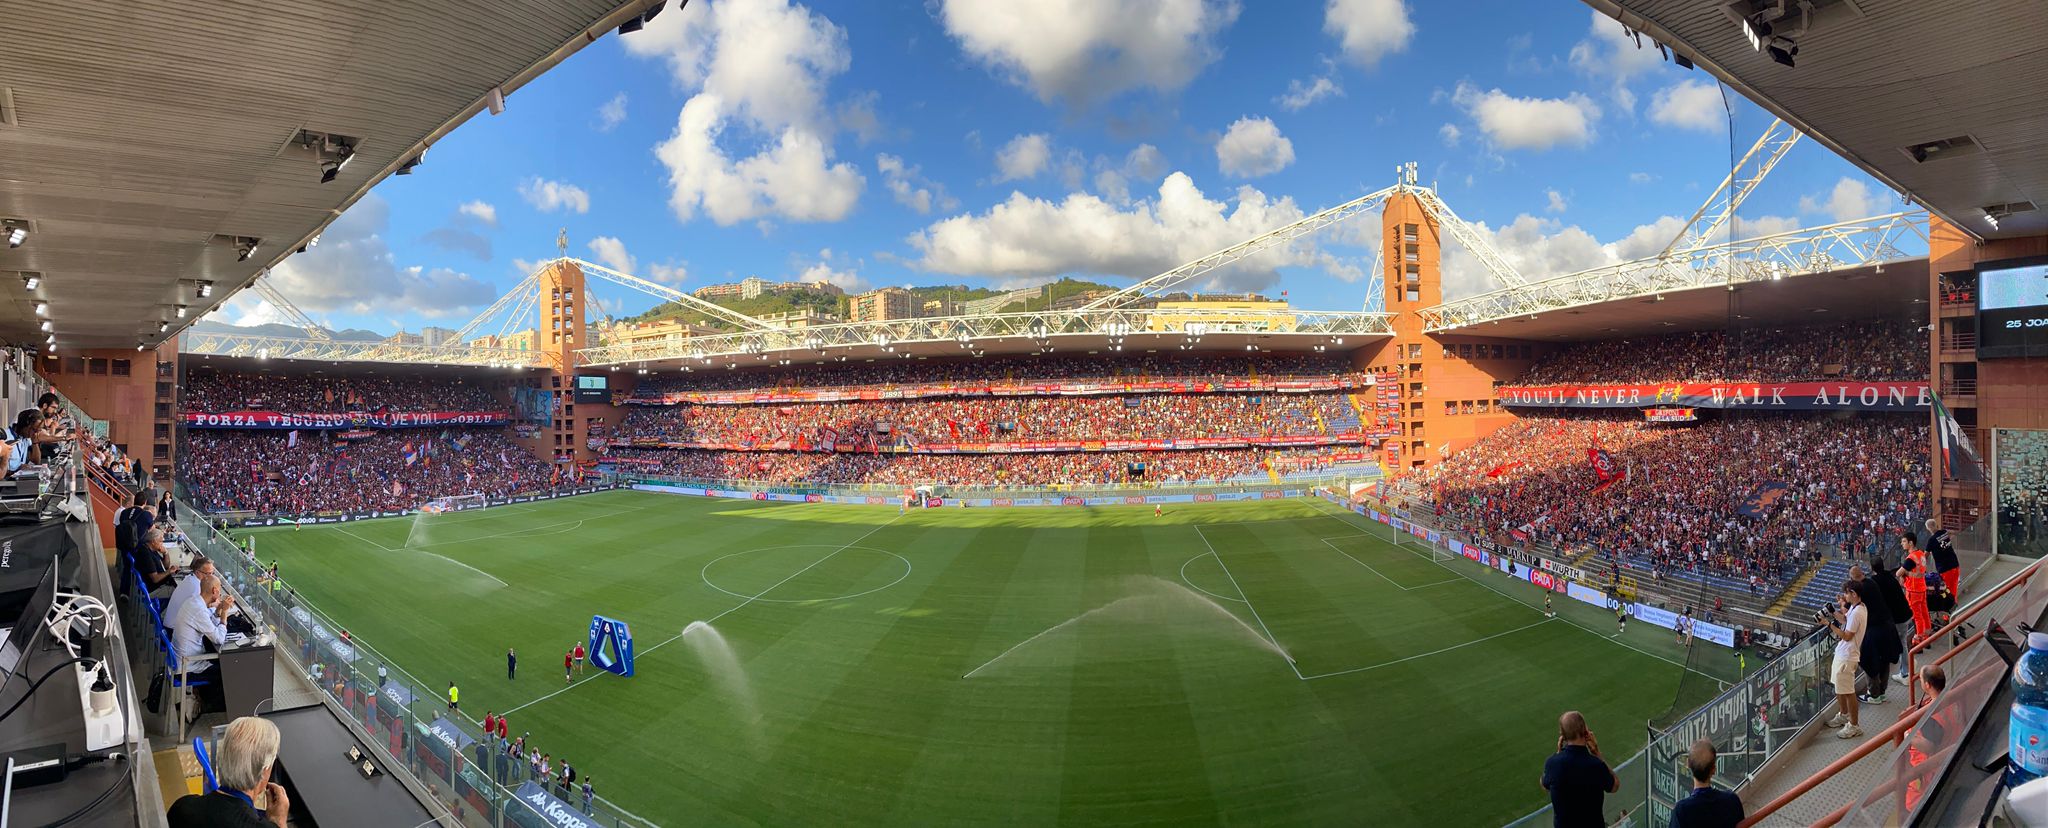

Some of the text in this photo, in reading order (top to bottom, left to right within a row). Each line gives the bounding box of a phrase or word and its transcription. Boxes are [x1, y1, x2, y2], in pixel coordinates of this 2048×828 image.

[2006, 320, 2022, 328] 25
[1512, 386, 1931, 406] YOU'LL NEVER WALK ALONE
[196, 415, 257, 426] FORZA
[1506, 547, 1537, 565] MARKUP
